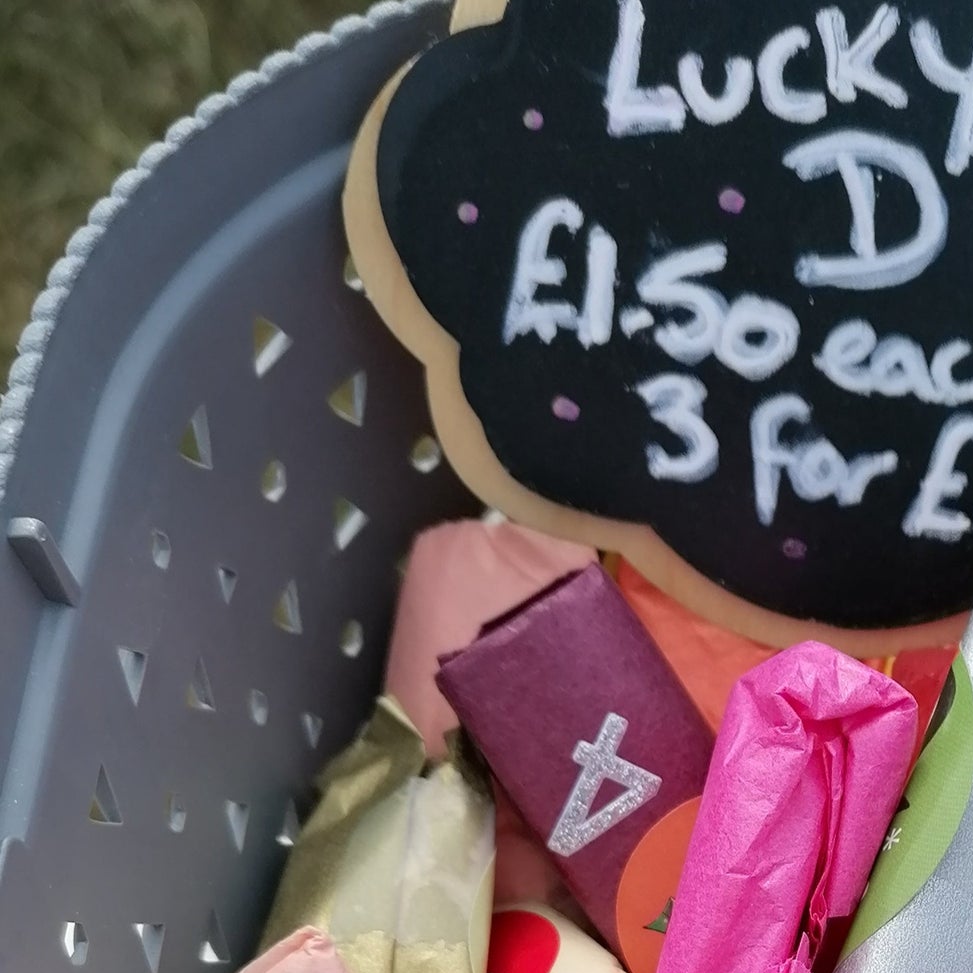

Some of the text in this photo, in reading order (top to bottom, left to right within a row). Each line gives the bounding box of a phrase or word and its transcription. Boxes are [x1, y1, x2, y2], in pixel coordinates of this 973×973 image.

[502, 197, 802, 382] £1.50
[635, 371, 720, 484] 3
[750, 392, 899, 527] for
[548, 712, 662, 857] 4
